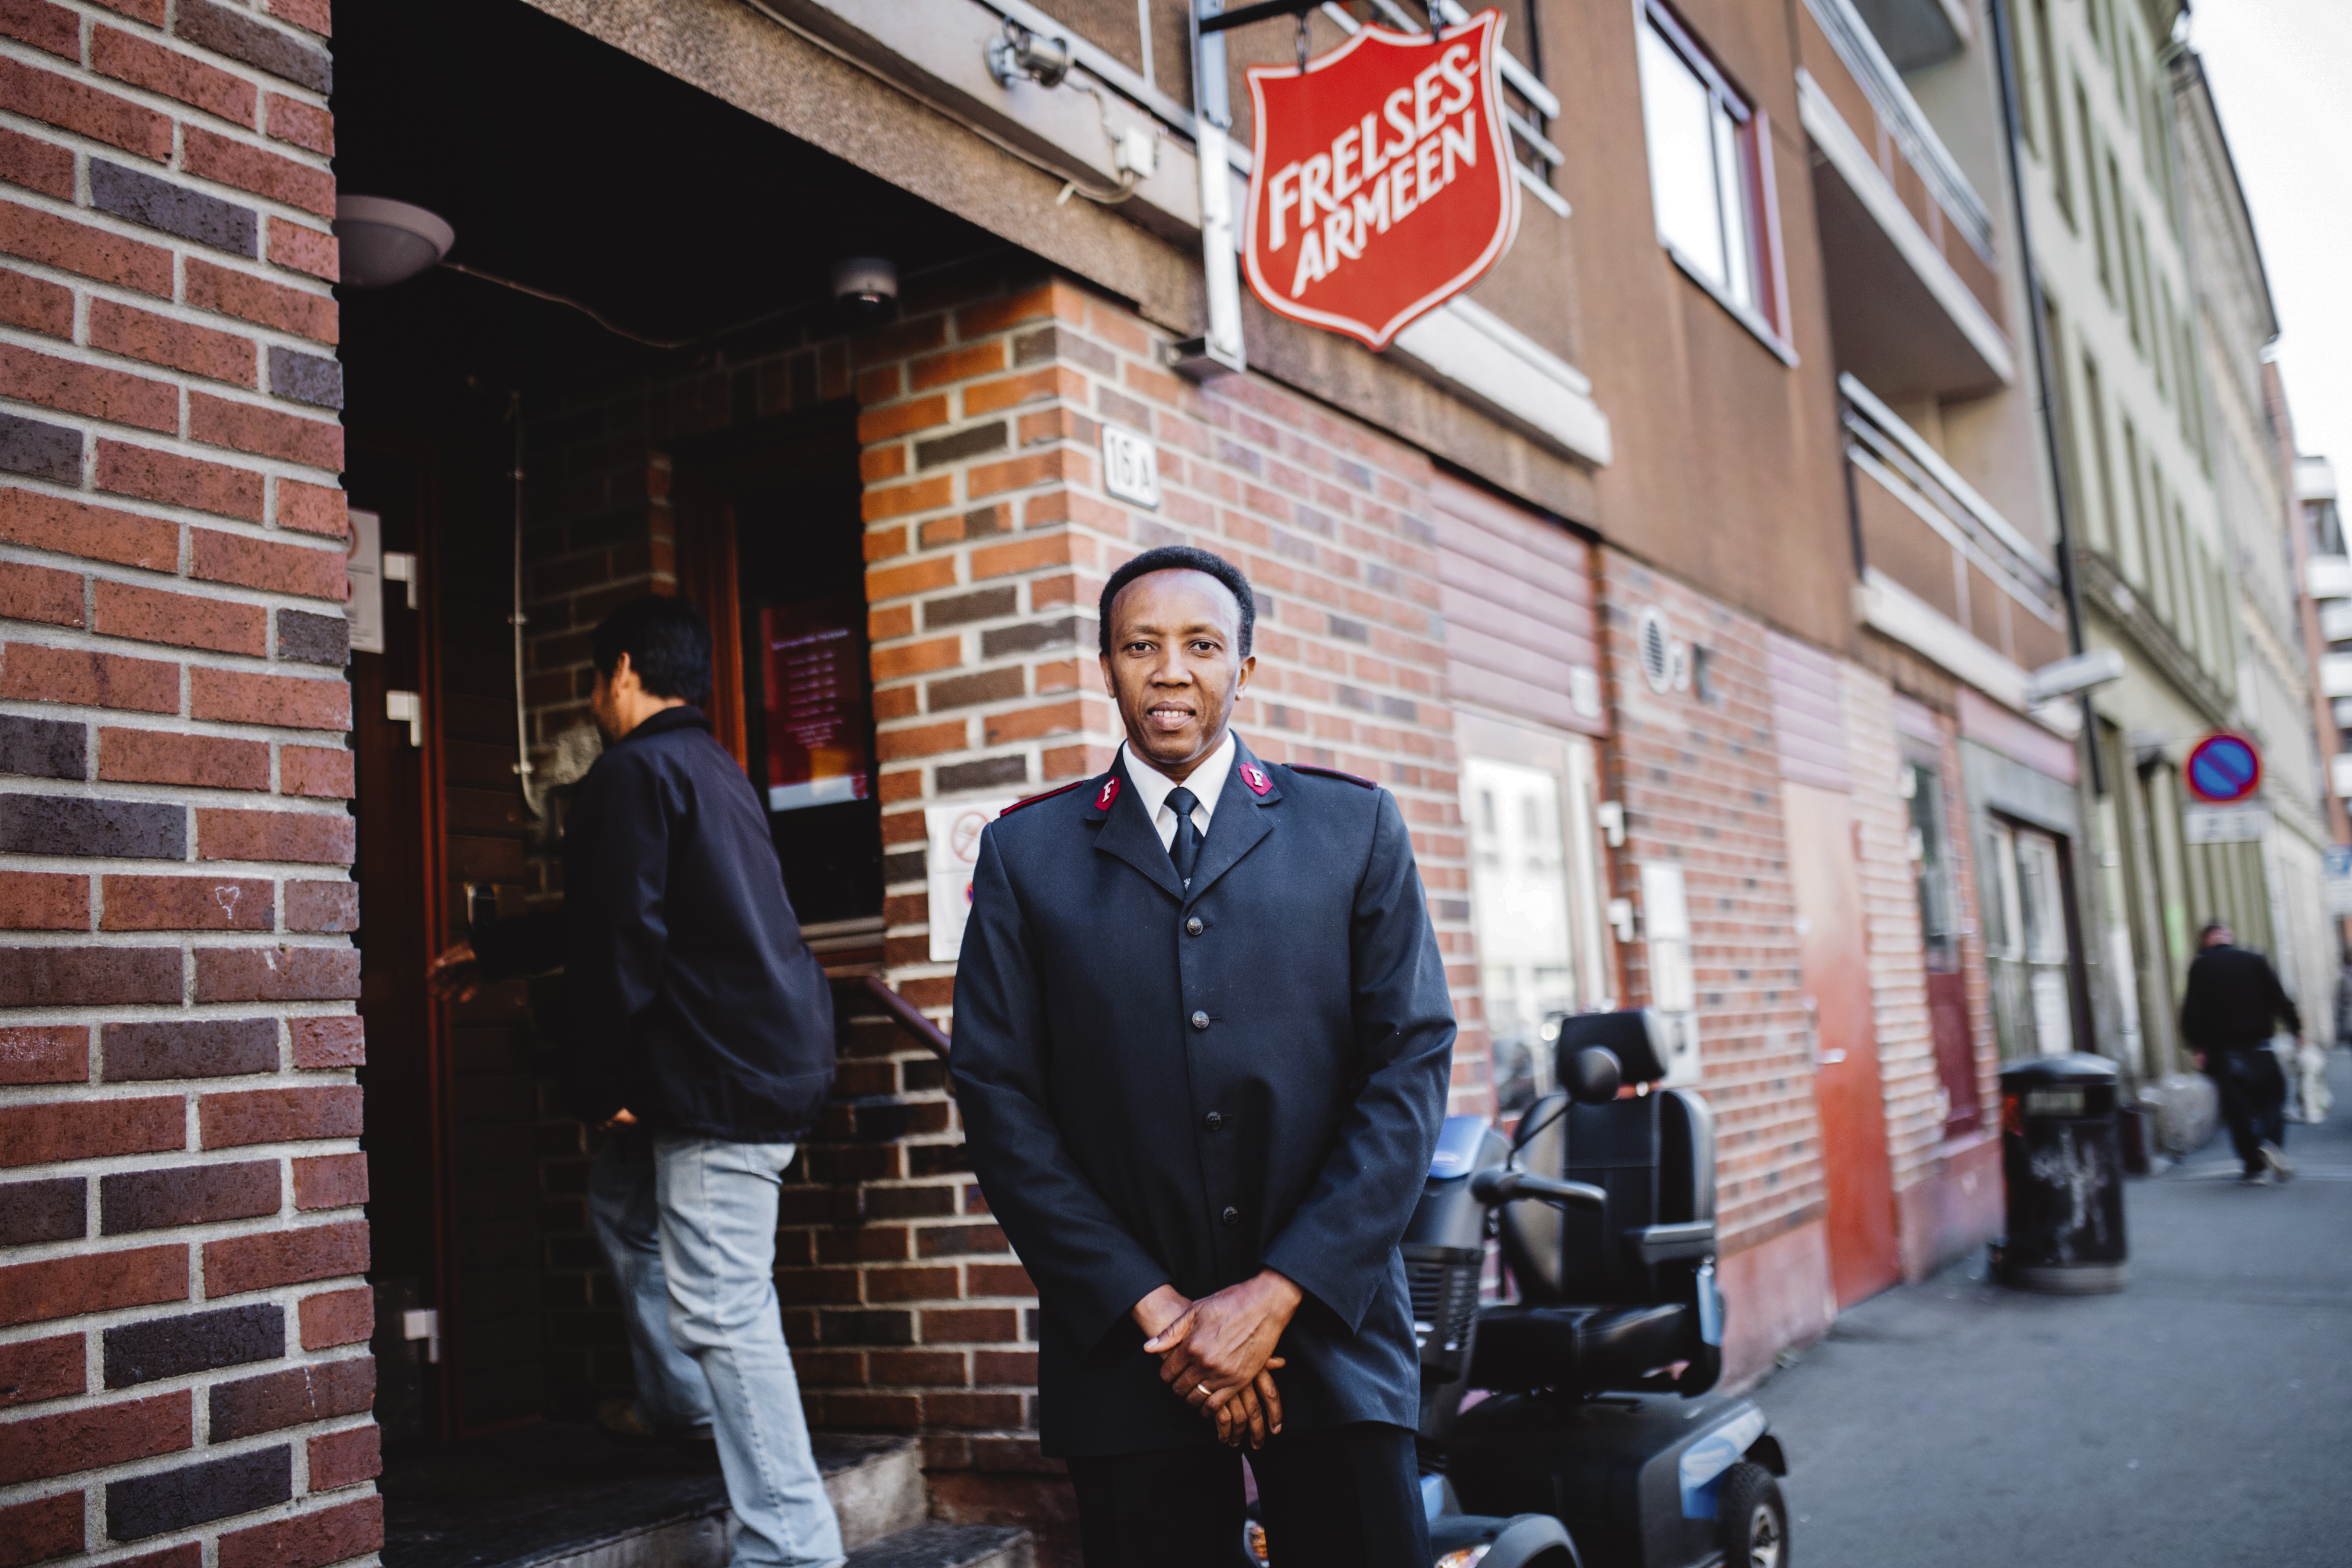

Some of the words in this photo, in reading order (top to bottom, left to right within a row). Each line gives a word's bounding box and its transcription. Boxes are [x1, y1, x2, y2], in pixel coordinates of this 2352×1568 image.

[1268, 43, 1480, 252] FRELSES-
[1291, 108, 1477, 299] ARMEEN
[1109, 435, 1152, 492] 16A
